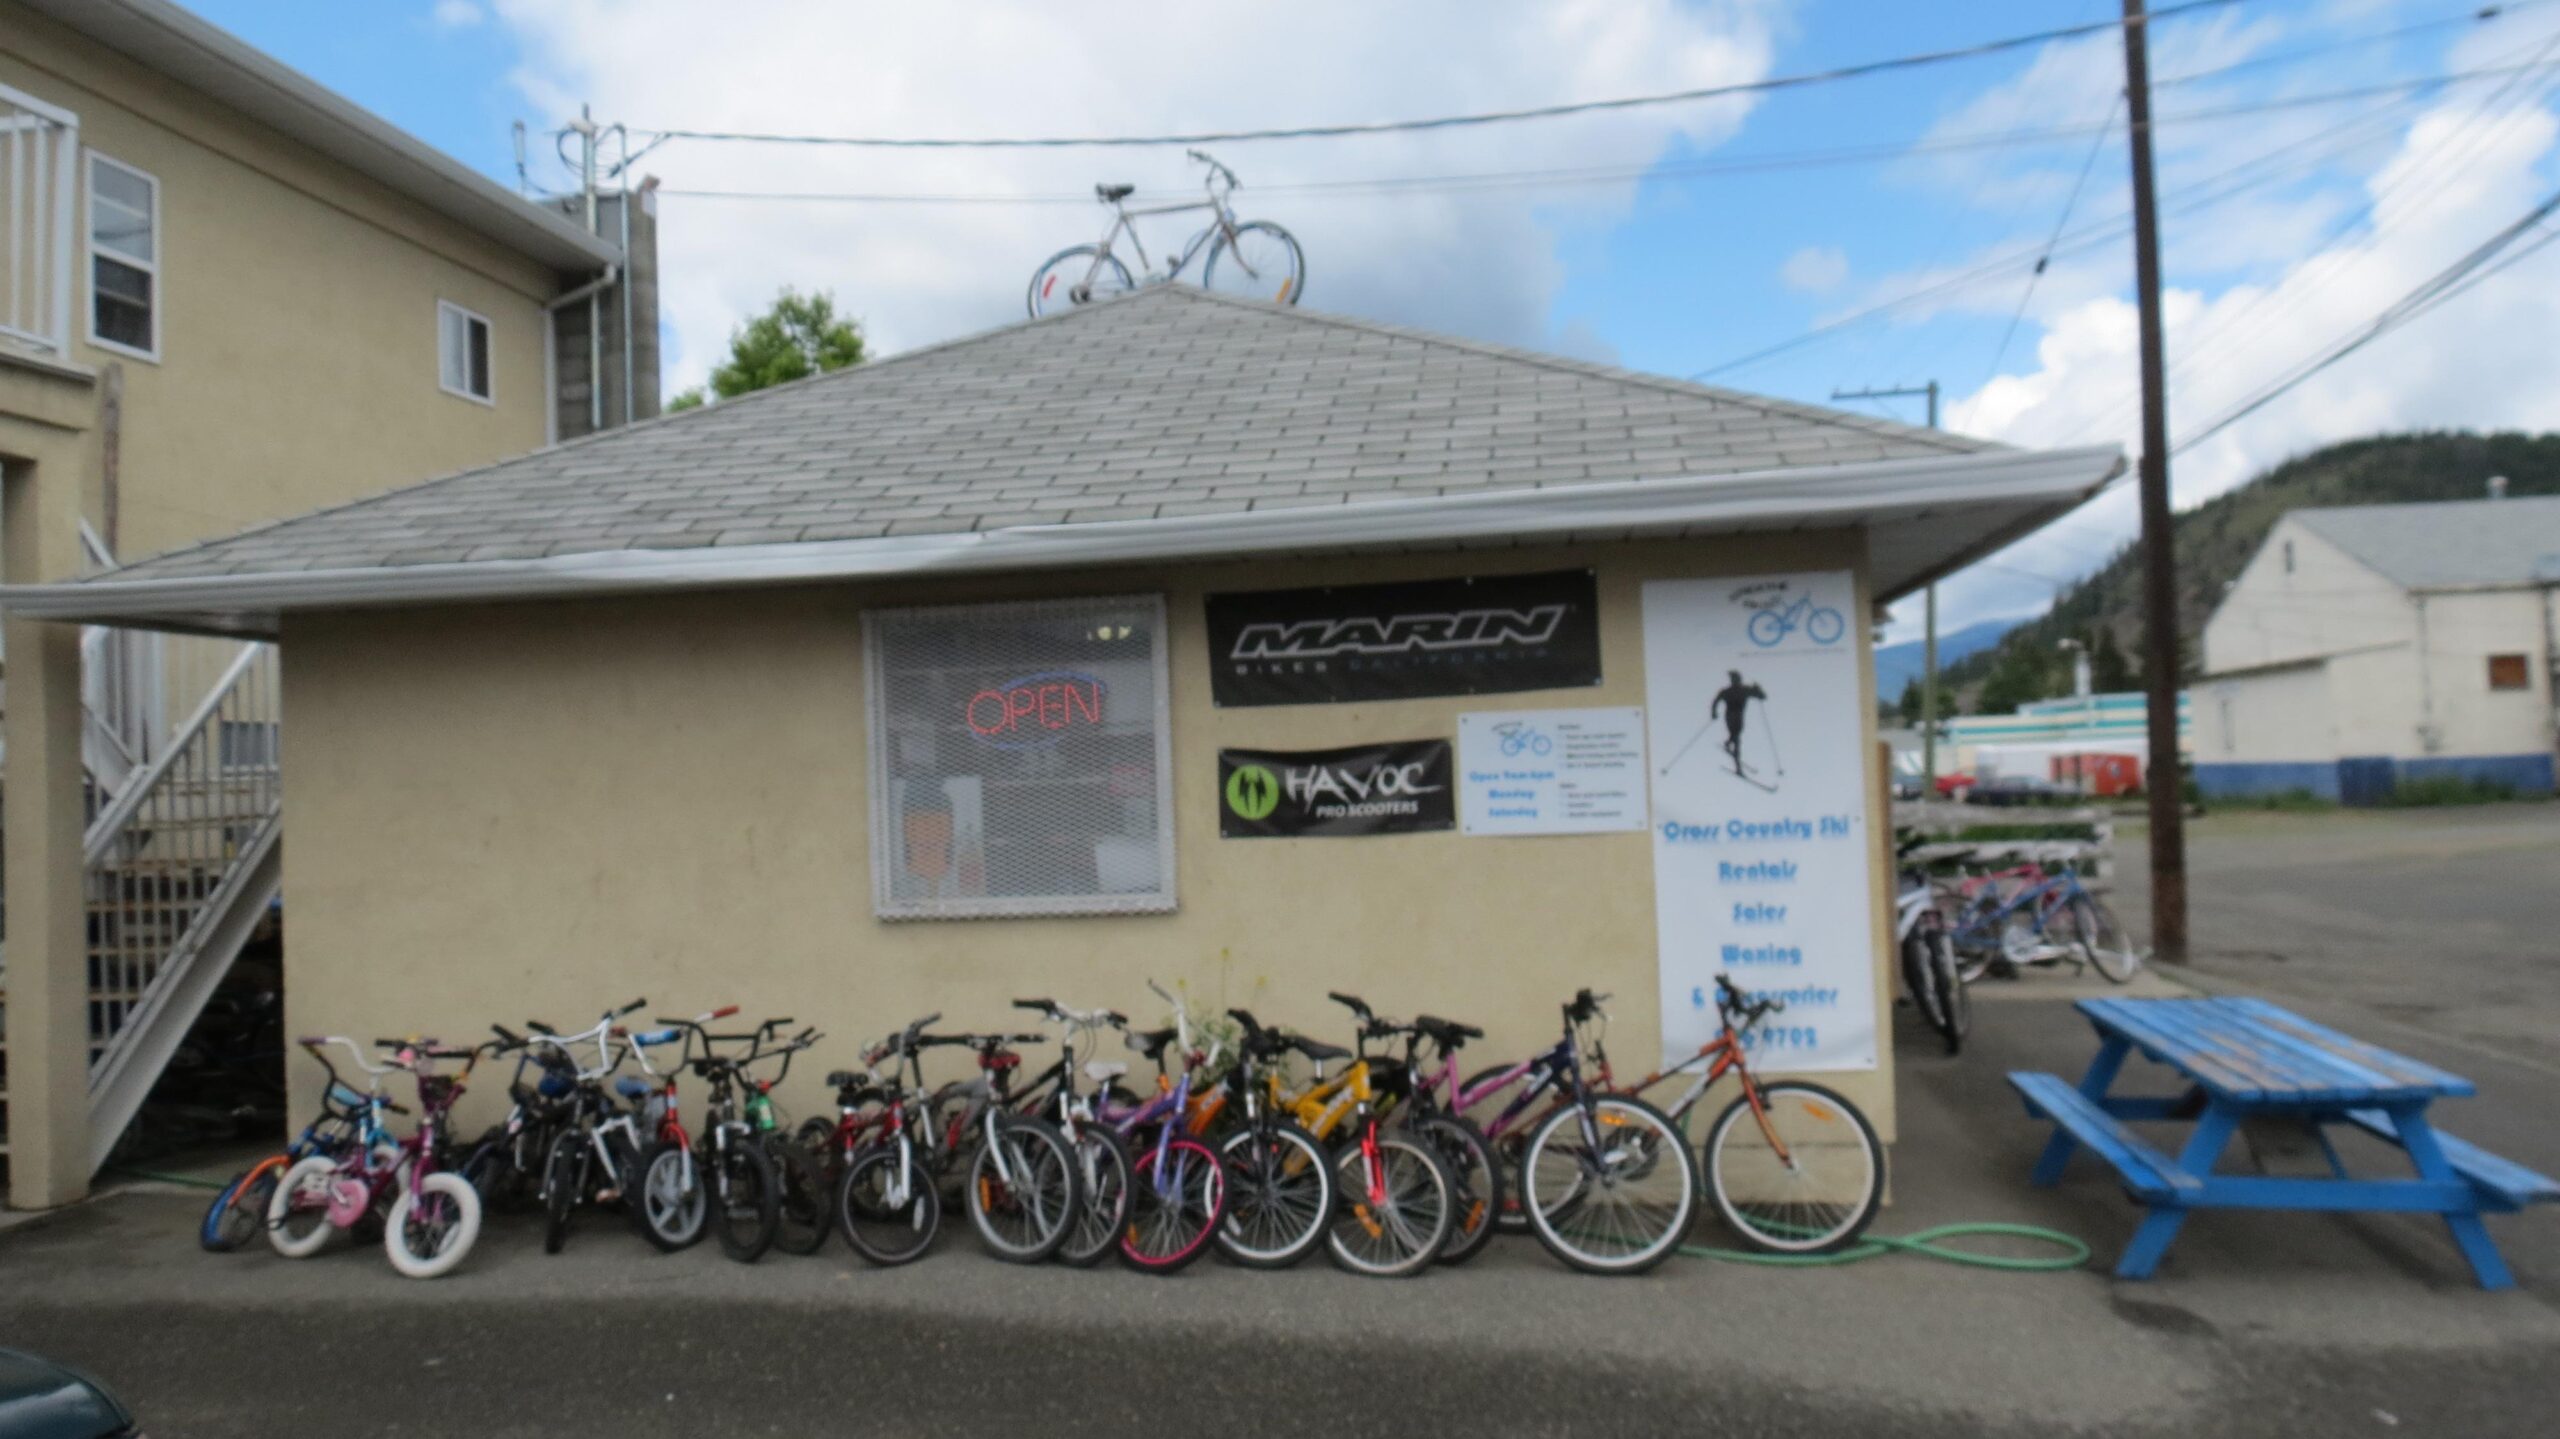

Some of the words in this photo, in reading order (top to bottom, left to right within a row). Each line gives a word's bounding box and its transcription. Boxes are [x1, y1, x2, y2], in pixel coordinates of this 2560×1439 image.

[1231, 604, 1567, 659] MARIN
[1236, 661, 1327, 675] BIKES
[966, 682, 1101, 735] OPEN
[1285, 761, 1447, 815] HAVOC
[1316, 805, 1346, 818] PRO
[1348, 800, 1418, 816] SCOOTERS
[1664, 821, 1719, 841] Cross
[1727, 818, 1813, 840] Country
[1820, 816, 1849, 833] Ski
[1718, 861, 1797, 881] Rentals
[1733, 903, 1786, 923] Sales
[1721, 944, 1803, 965] Waxing
